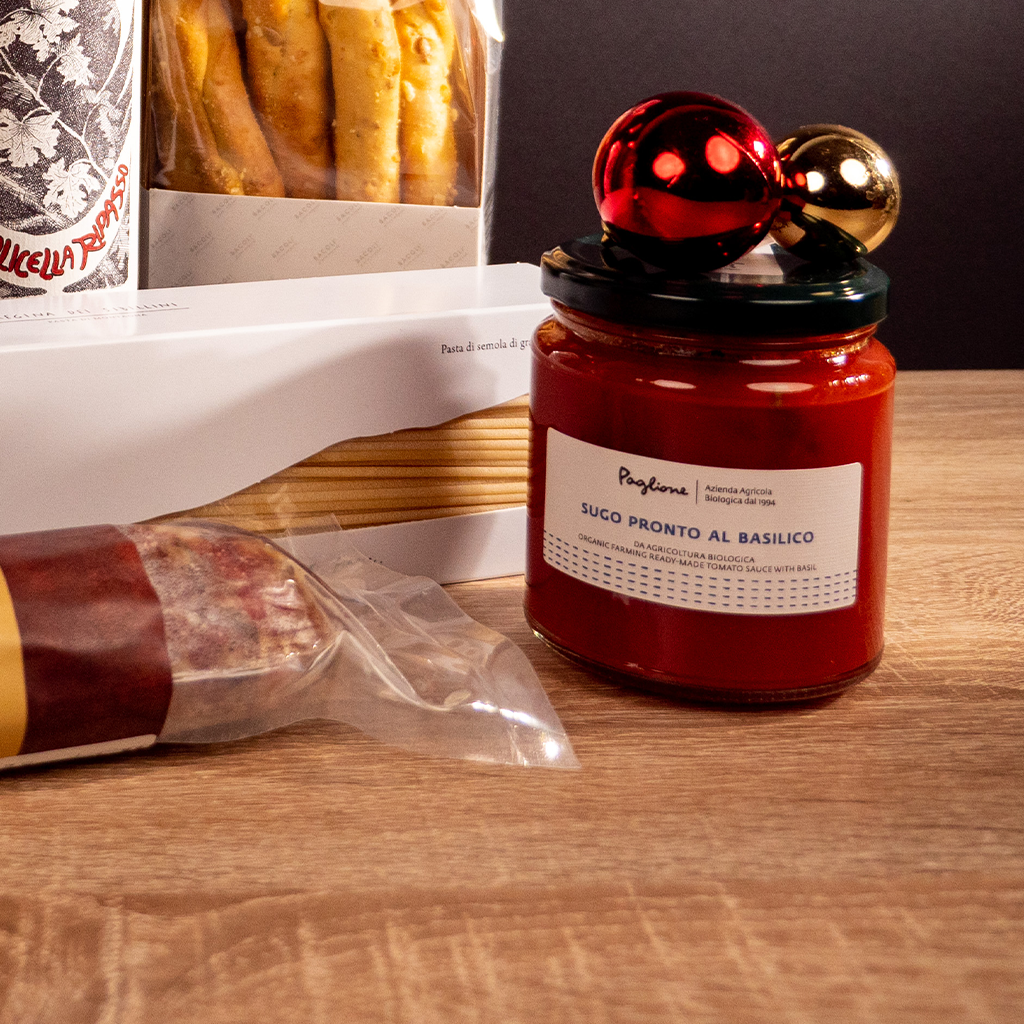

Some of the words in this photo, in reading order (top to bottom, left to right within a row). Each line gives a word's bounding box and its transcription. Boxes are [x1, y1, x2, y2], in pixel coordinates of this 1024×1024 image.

[72, 164, 129, 270] RIPASSO
[441, 344, 464, 354] Pasta
[466, 341, 474, 352] di
[477, 339, 507, 351] semola
[509, 338, 518, 348] di
[618, 466, 689, 496] Paglione
[705, 484, 738, 494] Azienda
[739, 487, 773, 496] Agricola
[705, 494, 743, 505] Biologica
[744, 497, 757, 505] dal
[758, 499, 776, 507] 1994
[581, 502, 622, 524] SUGO
[628, 515, 701, 540] PRONTO
[708, 529, 730, 543] AL
[738, 531, 814, 544] BASILICO
[578, 532, 610, 549] ORGANIC
[611, 543, 647, 559] FARMING
[649, 552, 705, 569] READY-MADE
[707, 562, 743, 572] TOMATO
[745, 565, 772, 573] SAUCE
[773, 565, 795, 573] WITH
[796, 564, 817, 572] BASIL
[633, 540, 645, 549] DA
[646, 543, 706, 560] AGRICOLTURA
[707, 553, 755, 563] BIOLOGICA
